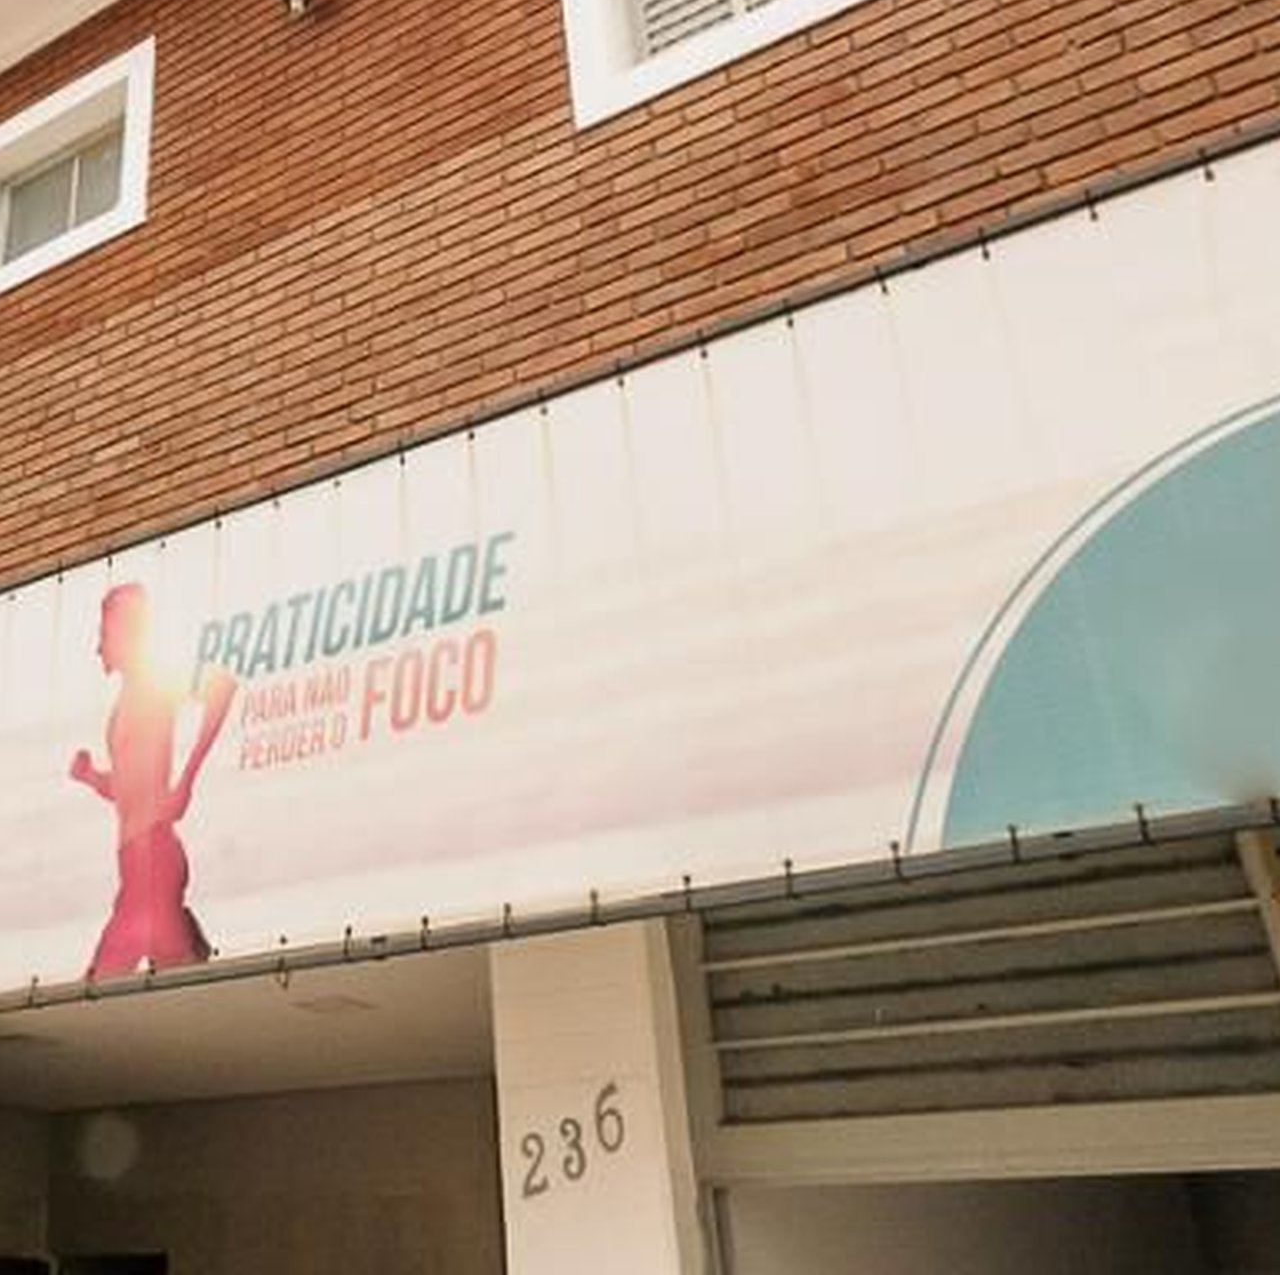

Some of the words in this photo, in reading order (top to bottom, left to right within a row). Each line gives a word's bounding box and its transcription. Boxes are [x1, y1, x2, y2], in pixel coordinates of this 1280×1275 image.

[193, 531, 515, 690] PRATICIDADE
[241, 682, 296, 728] PARA
[359, 629, 497, 742] FOCO
[522, 1081, 625, 1199] 236
